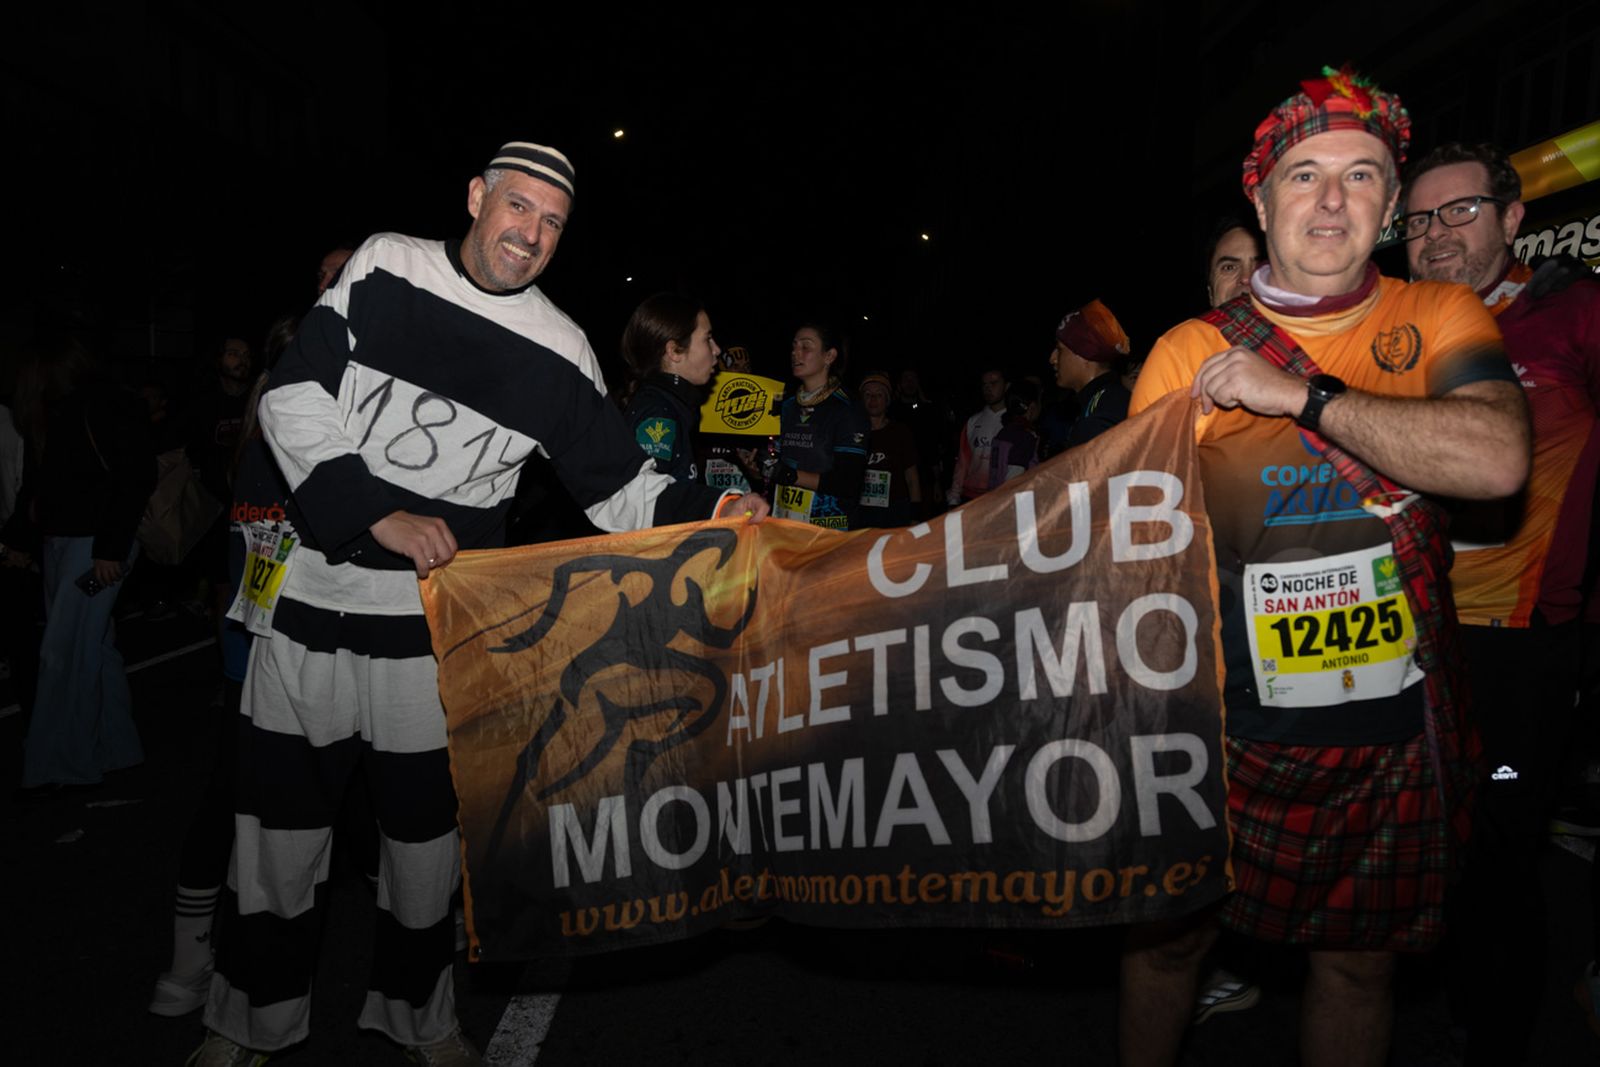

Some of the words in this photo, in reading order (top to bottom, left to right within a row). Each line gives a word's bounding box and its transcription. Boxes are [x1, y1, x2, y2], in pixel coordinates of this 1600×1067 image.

[715, 389, 766, 412] METAL
[722, 395, 768, 417] LUBE
[1261, 462, 1338, 487] COME
[866, 469, 1195, 599] CLUB
[1282, 574, 1335, 593] NOCHE
[1339, 570, 1358, 587] DE
[1264, 598, 1298, 613] SAN
[1303, 587, 1360, 611] ANTÓN
[1271, 599, 1403, 658] 12425
[726, 592, 1200, 747] ATLETISMO
[1321, 652, 1369, 670] ANTONIO
[548, 732, 1217, 889] MONTEMAYOR
